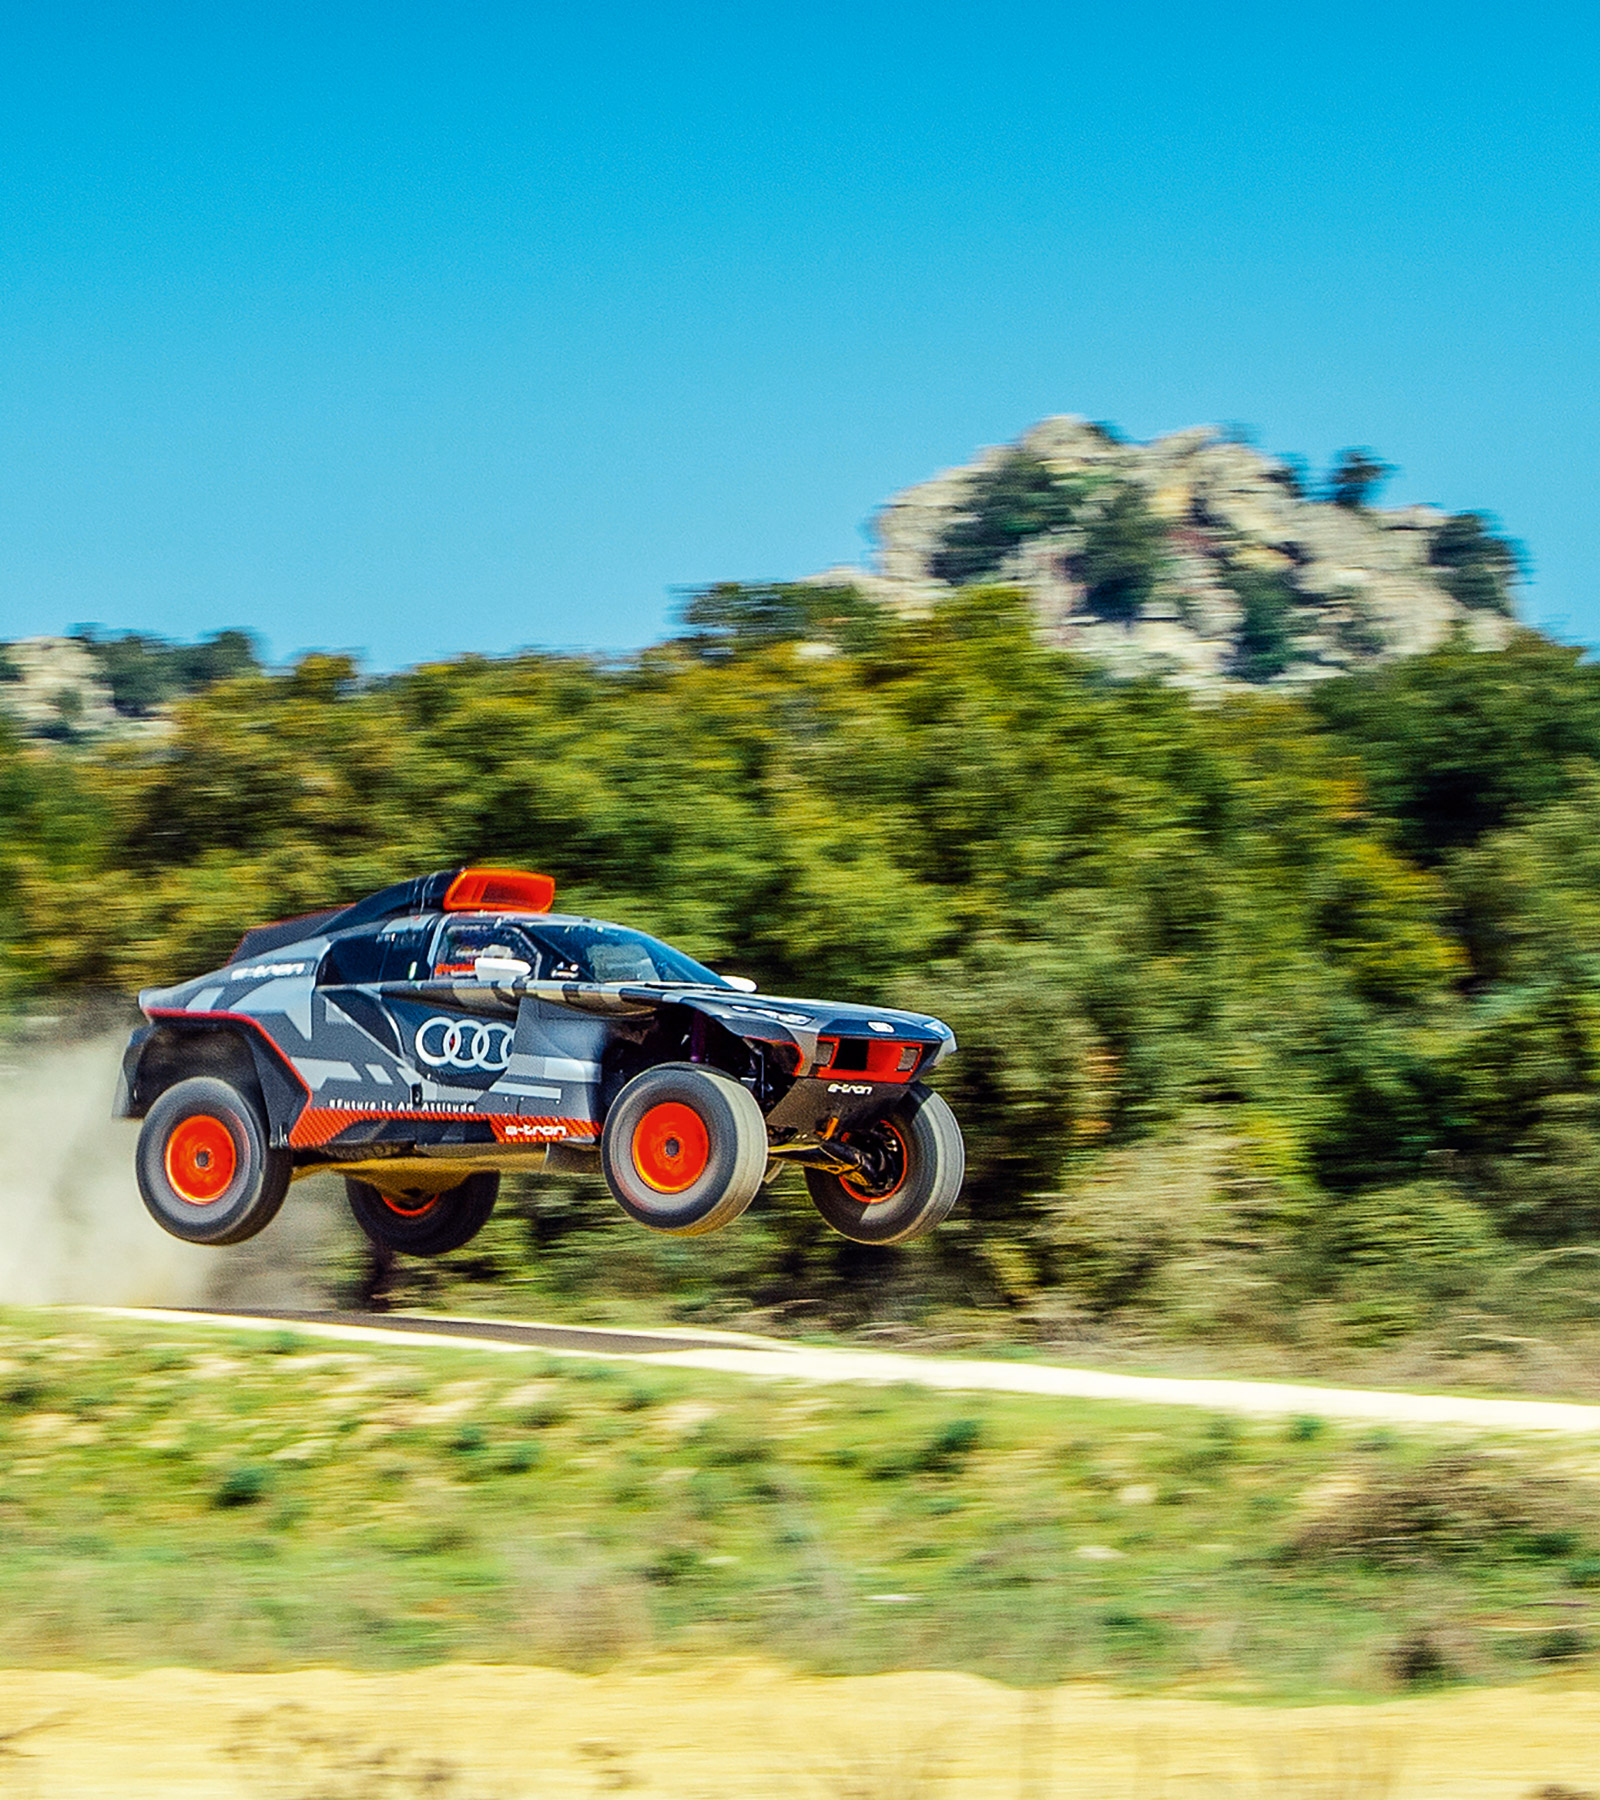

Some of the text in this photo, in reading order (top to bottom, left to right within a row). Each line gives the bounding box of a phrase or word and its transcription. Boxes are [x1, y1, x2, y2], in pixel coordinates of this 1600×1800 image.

[827, 1083, 873, 1095] e-tron
[422, 1102, 475, 1113] Attitude
[505, 1125, 567, 1136] e-tron
